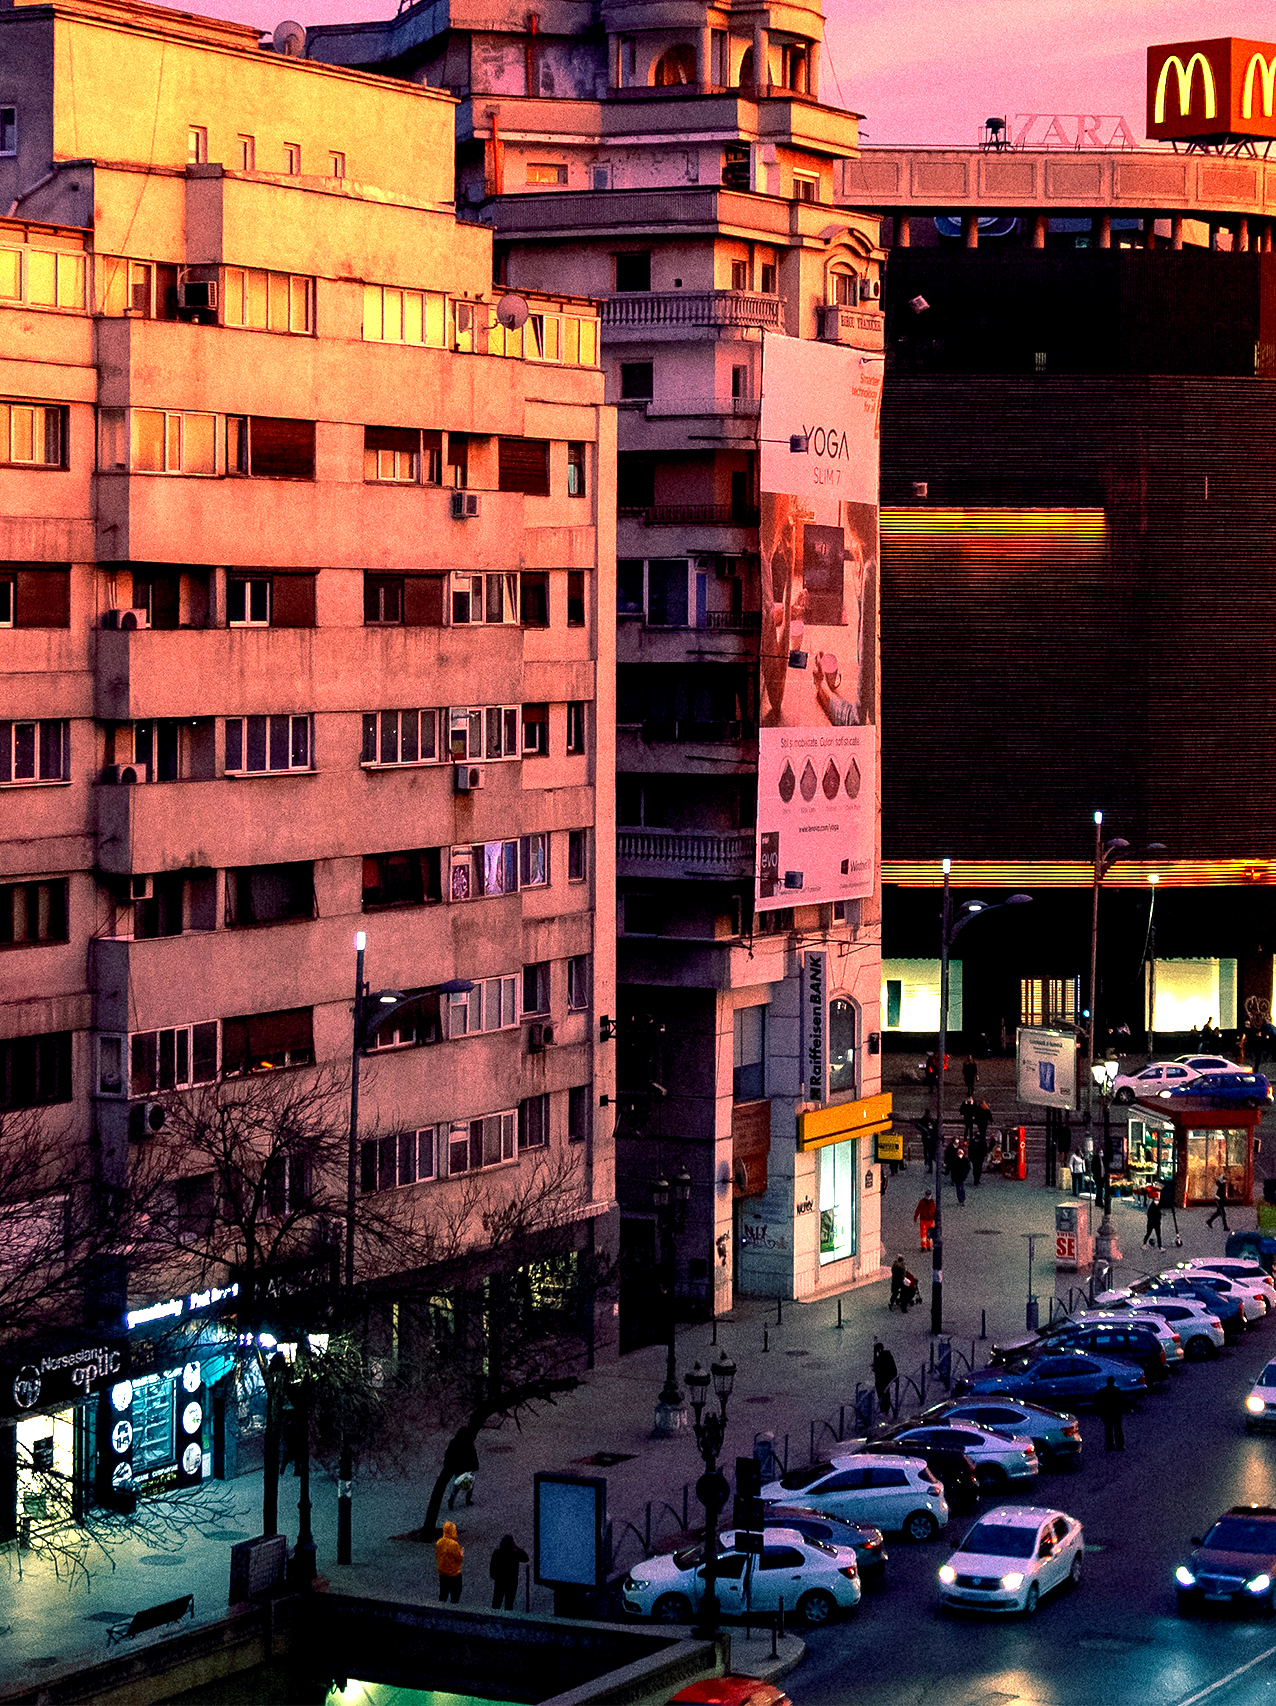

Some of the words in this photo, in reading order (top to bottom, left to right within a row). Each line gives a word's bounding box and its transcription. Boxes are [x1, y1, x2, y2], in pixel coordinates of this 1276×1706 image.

[1014, 113, 1139, 147] ZARA
[803, 424, 849, 460] YOGA
[813, 466, 834, 485] SLIM
[836, 469, 841, 485] 7
[761, 852, 778, 868] evo
[71, 1346, 120, 1394] optic
